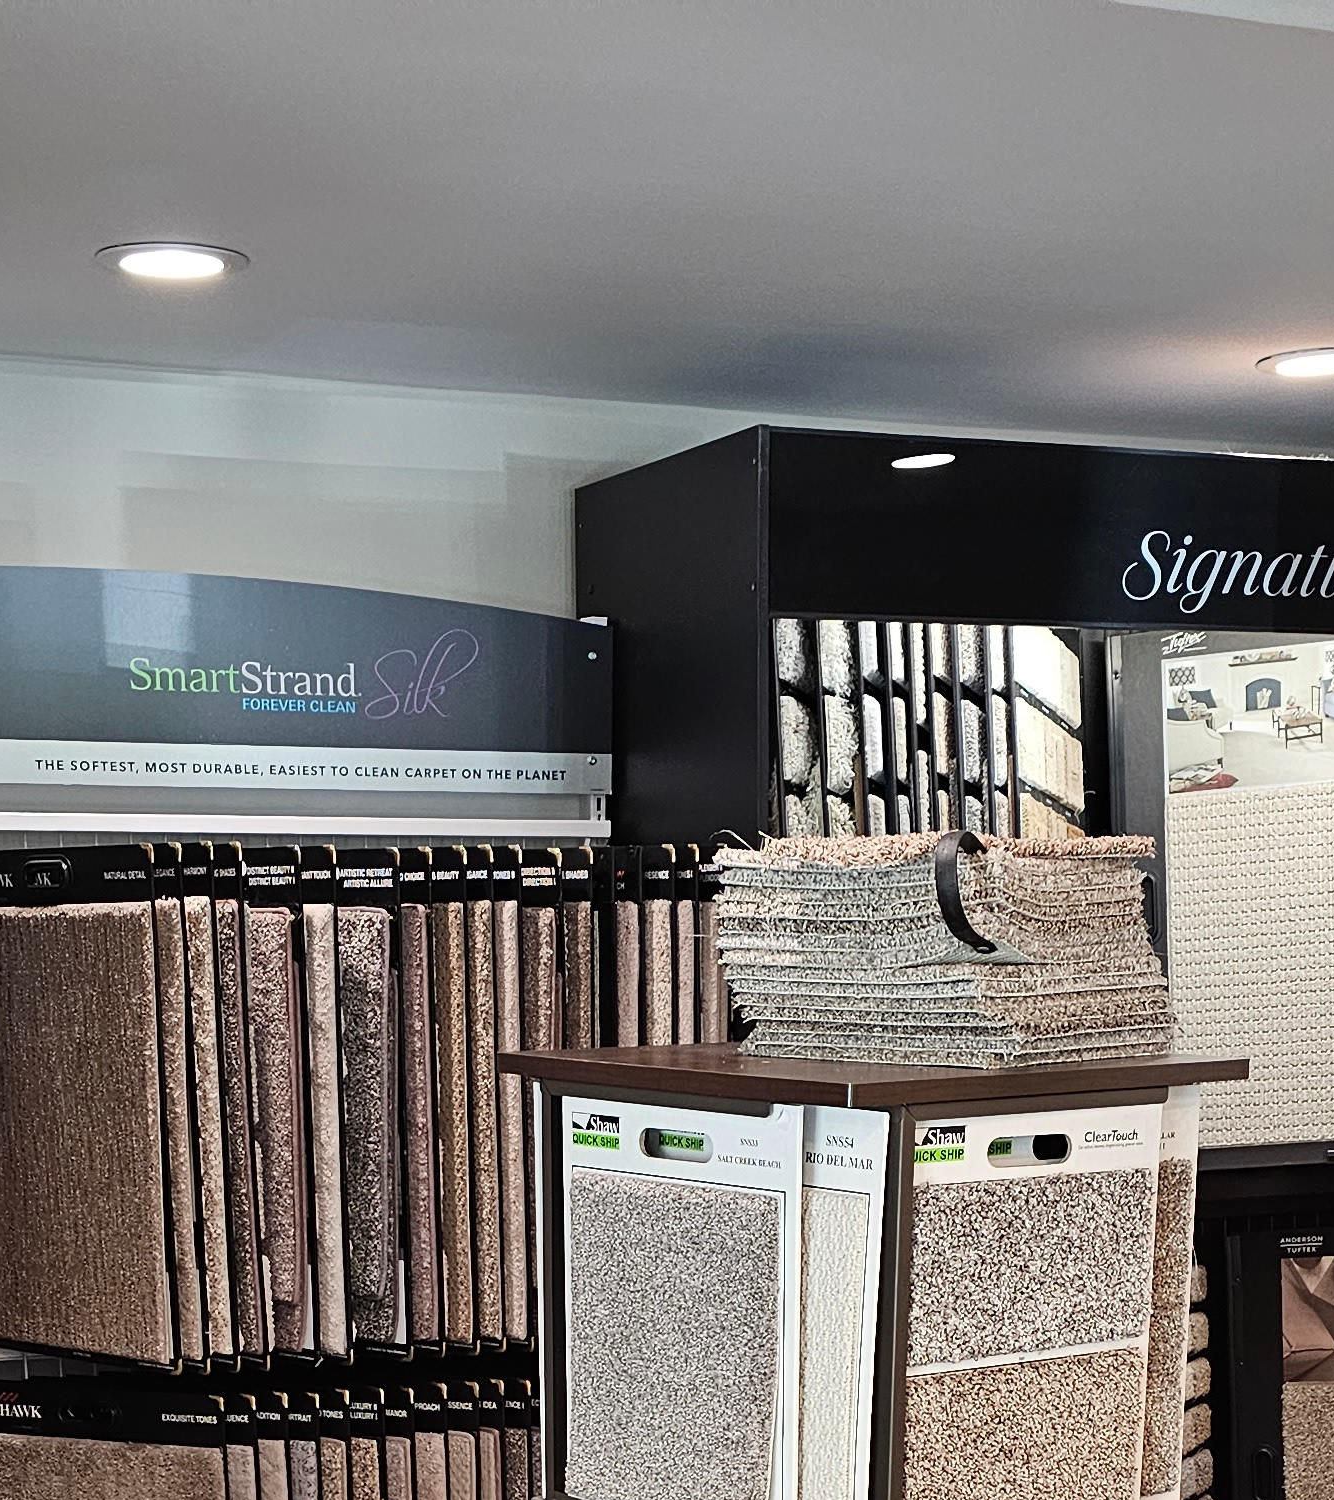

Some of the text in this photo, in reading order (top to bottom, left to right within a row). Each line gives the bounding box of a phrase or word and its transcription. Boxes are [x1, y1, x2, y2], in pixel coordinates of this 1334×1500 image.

[364, 628, 479, 720] Silk
[242, 697, 357, 714] FOREVER CLEAN
[35, 759, 567, 781] THE SOFTEST, MOST DURABLE, EASIEST TO CLEAN CARPET ON THE PLANET
[590, 1116, 619, 1134] Shaw
[572, 1134, 620, 1149] QUICK SHIP
[659, 1133, 704, 1150] QUICK SHIP
[826, 1135, 855, 1149] SNS54
[928, 1128, 964, 1146] Shaw
[1084, 1129, 1138, 1143] ClearTouch
[940, 1149, 964, 1161] SHIP
[988, 1142, 1012, 1155] SHIP
[805, 1151, 874, 1171] RIO DEL MAR
[1280, 1235, 1324, 1244] ANDERSON
[161, 1413, 218, 1425] EXQUISITE TONES
